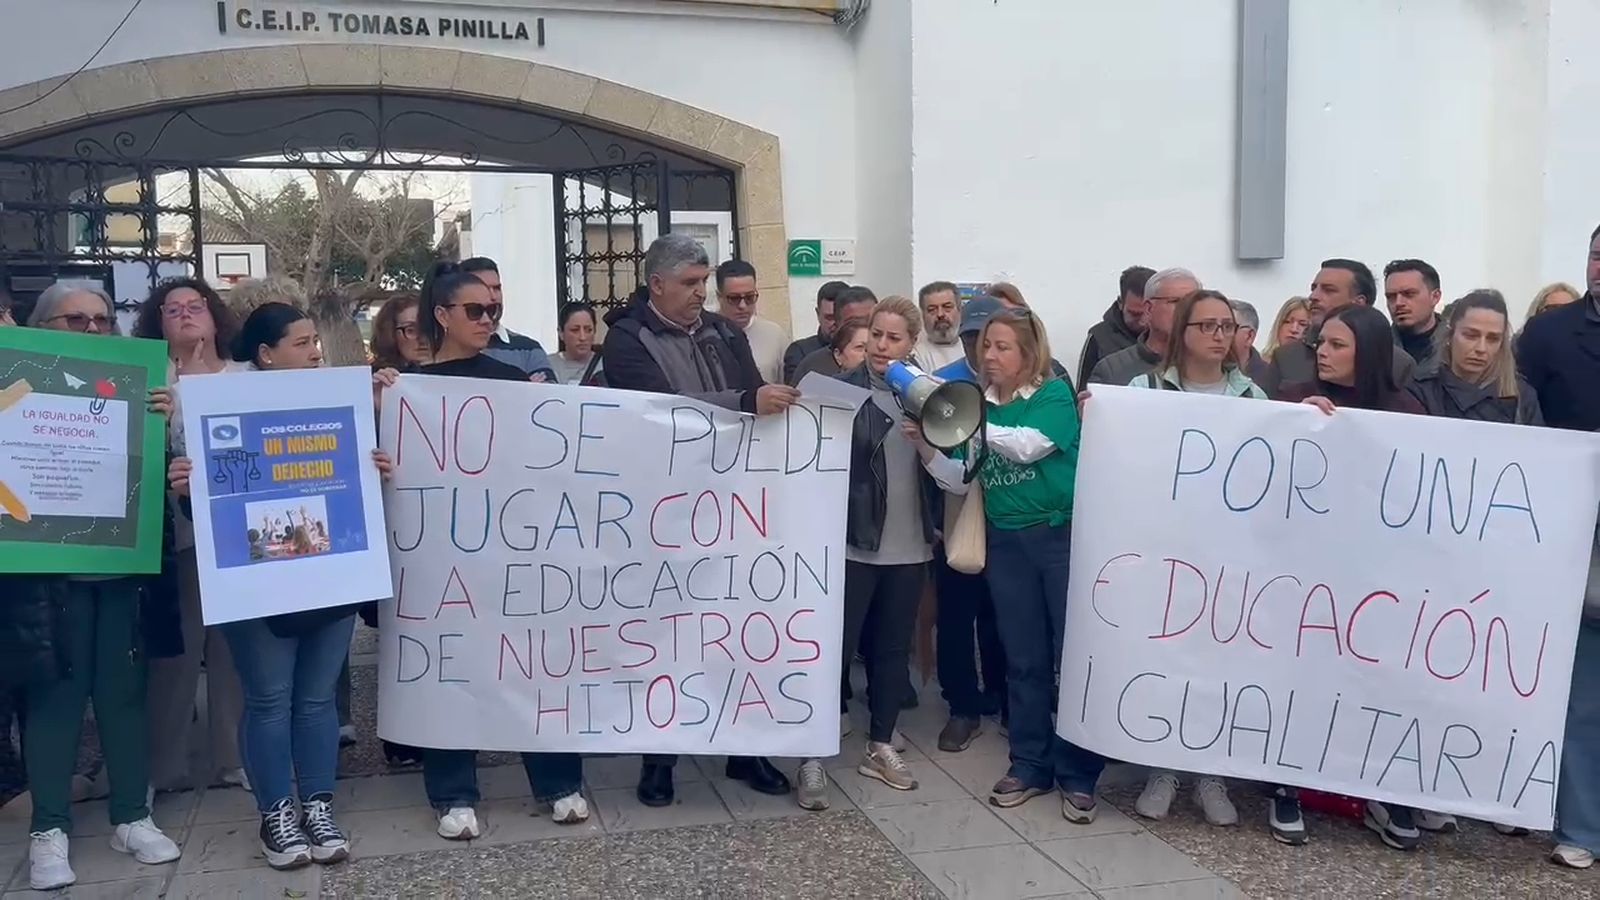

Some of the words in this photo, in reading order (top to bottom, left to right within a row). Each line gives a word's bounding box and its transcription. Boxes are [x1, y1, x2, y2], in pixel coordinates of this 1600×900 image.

[235, 8, 320, 32] C.E.I.P.
[328, 12, 431, 36] TOMASA
[438, 18, 530, 41] PINILLA
[22, 409, 36, 419] LA
[38, 410, 91, 423] IGUALDAD
[93, 414, 110, 425] NO
[32, 424, 47, 434] SE
[260, 425, 286, 435] DOS
[286, 421, 344, 434] COLEGIOS
[396, 395, 495, 476] NO
[525, 399, 620, 477] SE
[668, 402, 856, 477] PUEDE
[263, 437, 284, 457] UN
[287, 433, 338, 455] MISMO
[271, 459, 335, 482] DERECHO
[1171, 428, 1330, 520] POR
[1380, 448, 1541, 544] UNA
[392, 485, 634, 553] JUGAR
[650, 487, 768, 549] CON
[396, 566, 477, 620] LA
[501, 545, 829, 617] EDUCACIÓN
[397, 633, 470, 683] DE
[498, 609, 821, 680] NUESTROS
[535, 668, 814, 743] HIJOS/AS
